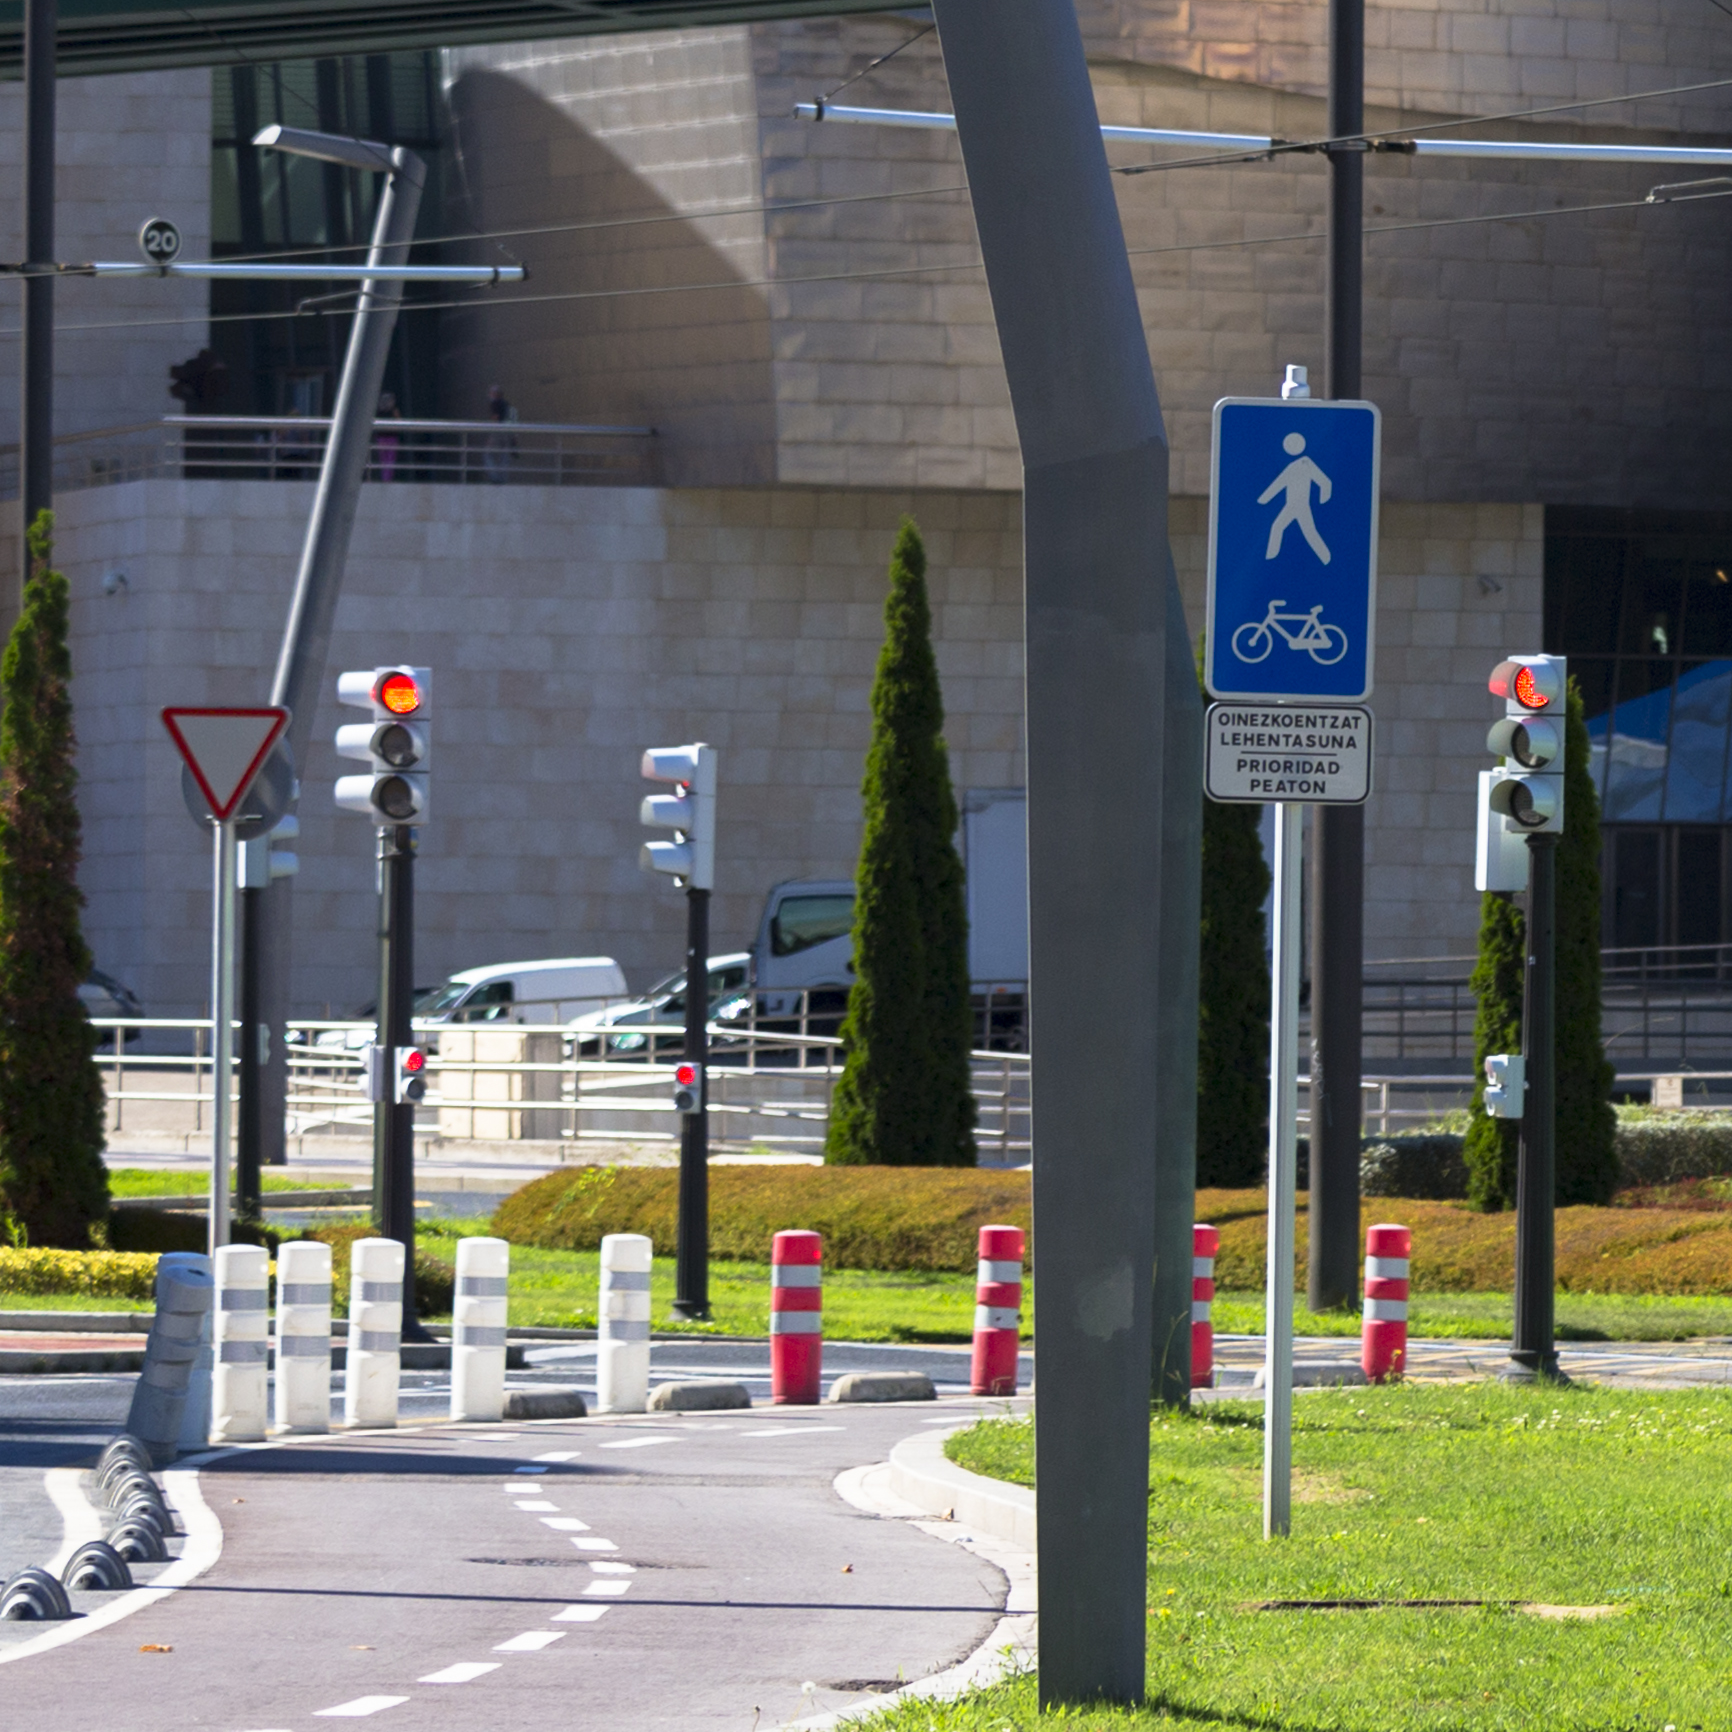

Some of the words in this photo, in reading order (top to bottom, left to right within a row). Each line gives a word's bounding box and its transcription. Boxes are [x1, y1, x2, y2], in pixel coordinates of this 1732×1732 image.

[147, 230, 176, 253] 20
[1218, 712, 1362, 729] OINEZKOENTZAT
[1220, 732, 1357, 749] LEHENTASUNA
[1236, 759, 1340, 775] PRIORIDAD
[1250, 779, 1326, 794] PEATON
